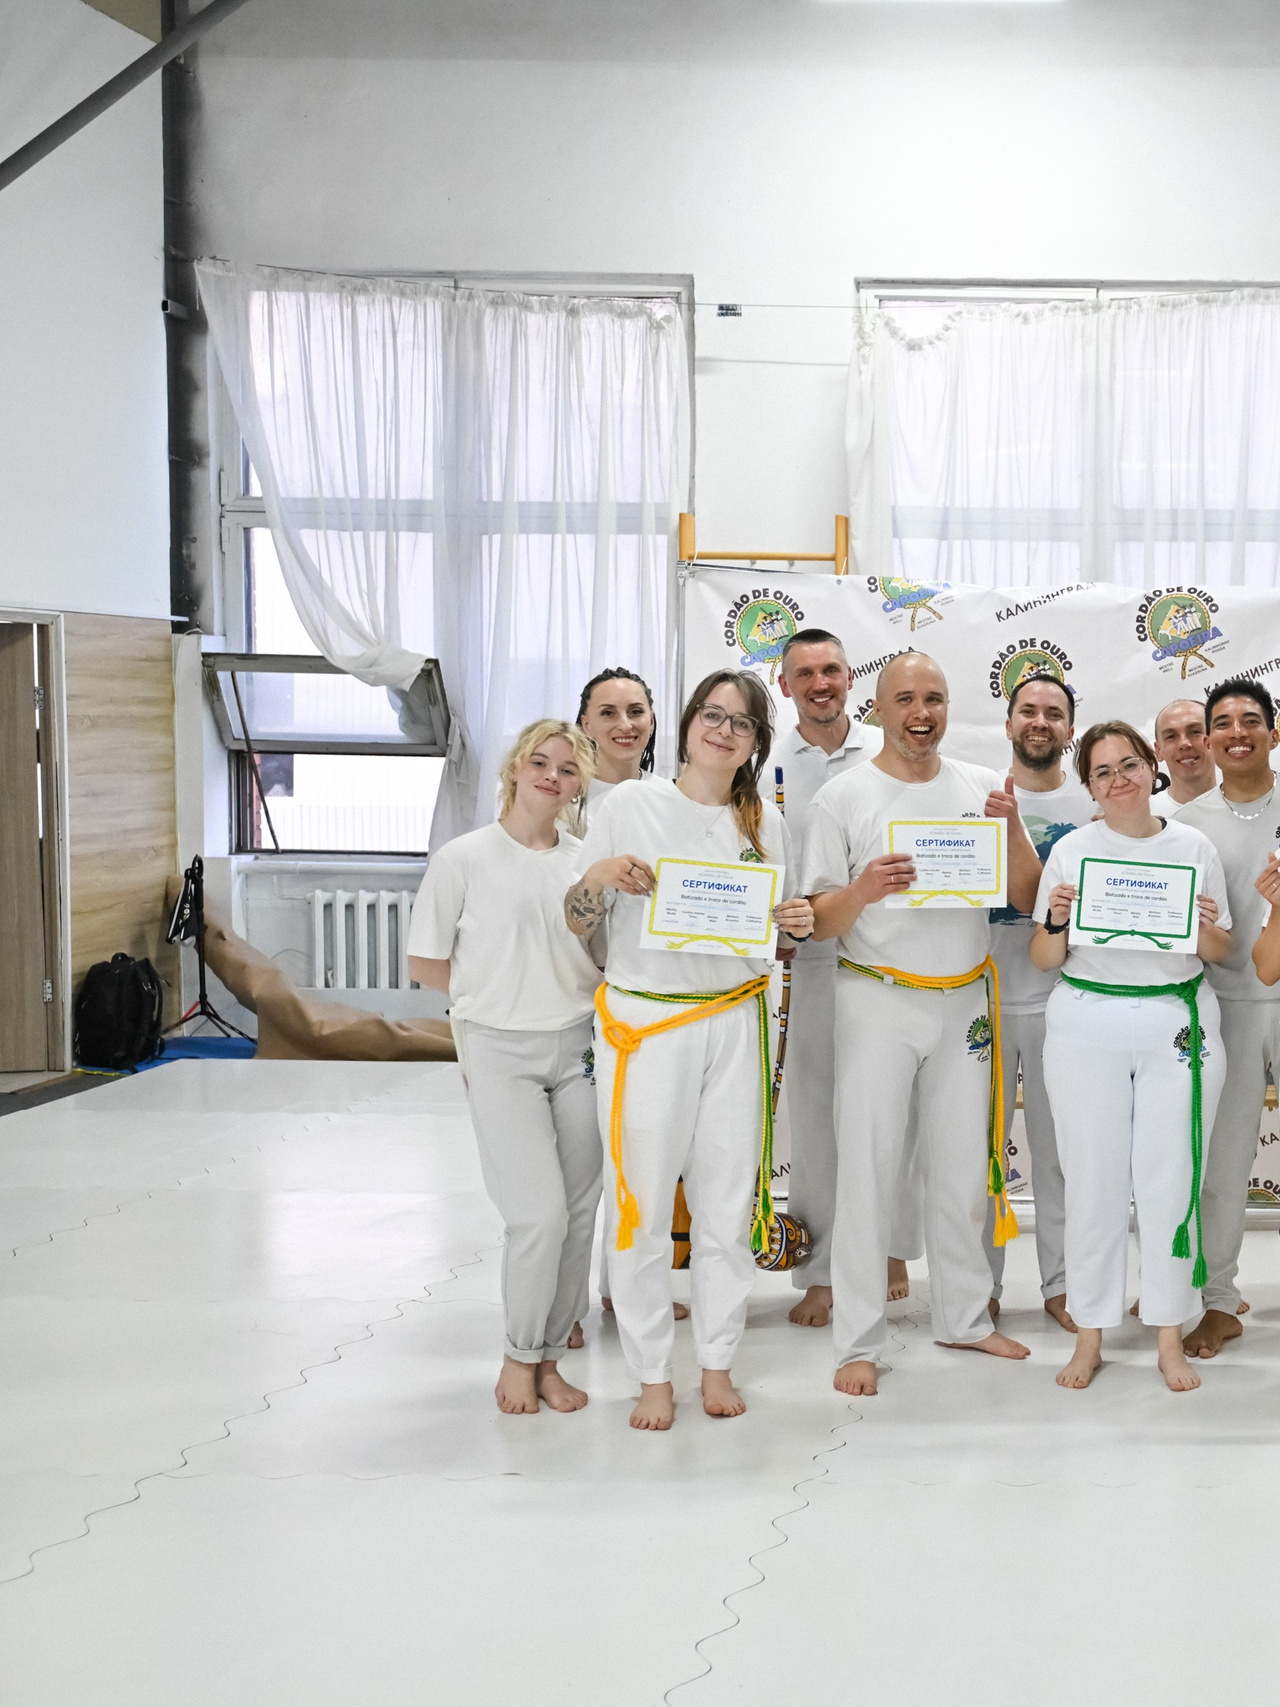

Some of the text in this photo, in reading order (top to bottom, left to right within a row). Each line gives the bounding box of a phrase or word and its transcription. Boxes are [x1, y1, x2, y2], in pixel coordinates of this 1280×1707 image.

[724, 588, 805, 647] CORDÃO DE OURO
[1135, 585, 1220, 643] CORDÃO DE OURO
[1151, 626, 1223, 662] CAPOEIRA
[990, 638, 1073, 699] CORDÃO DE OURO
[915, 839, 976, 847] СЕРТИФИКАТ
[682, 879, 748, 894] СЕРТИФИКАТ
[1106, 878, 1169, 890] СЕРТИФИКАТ
